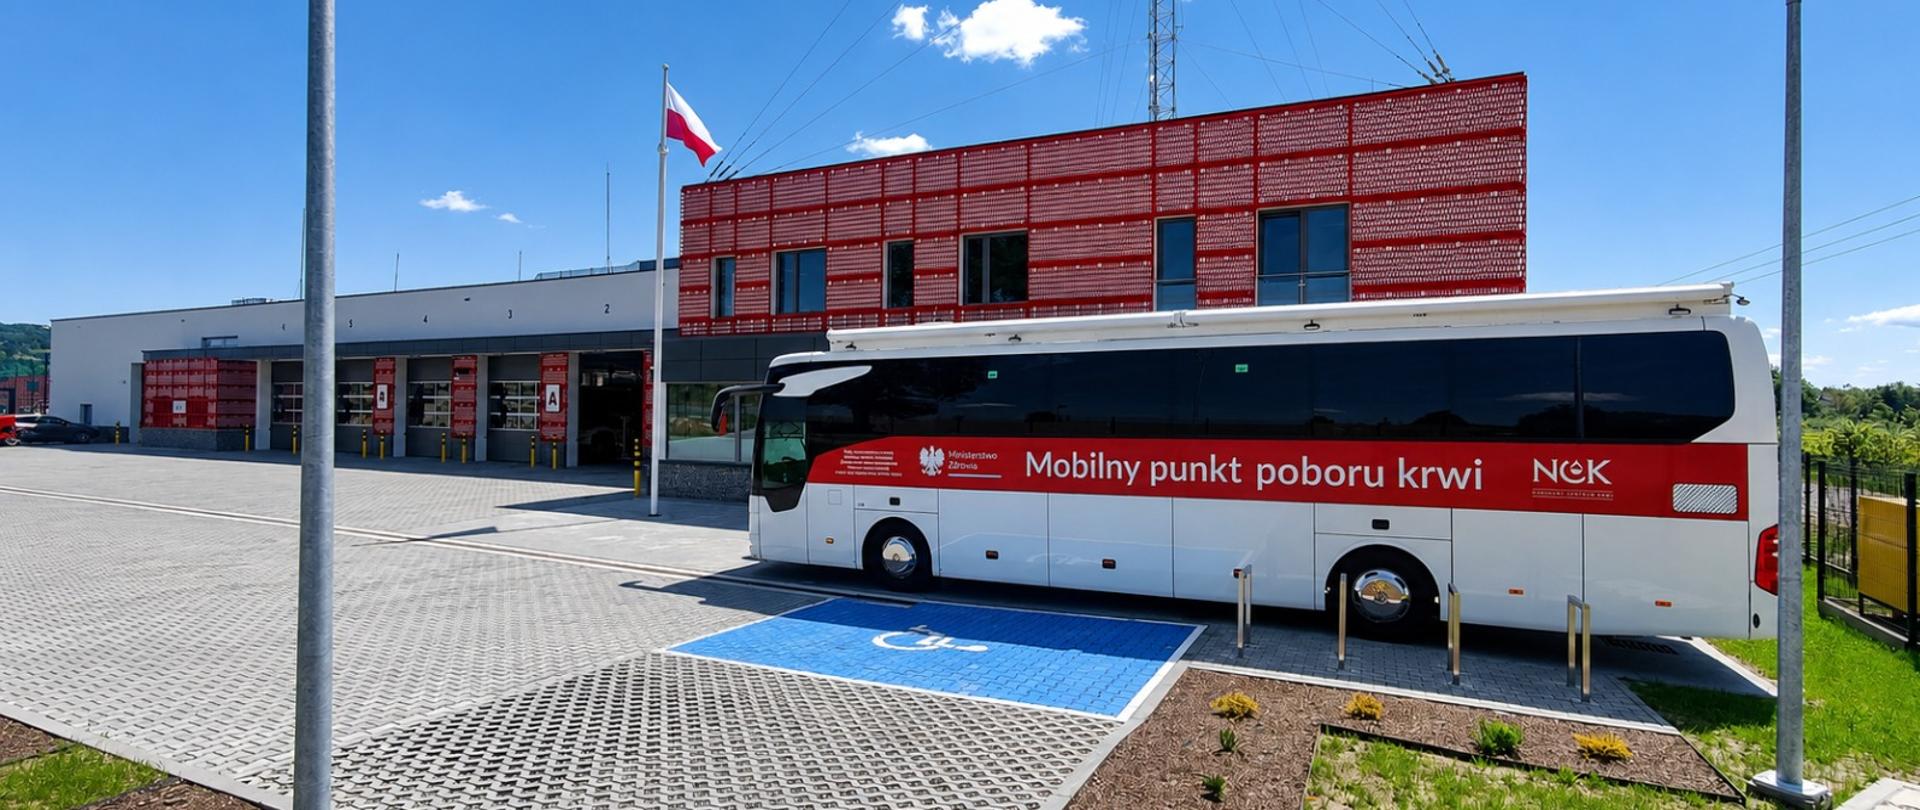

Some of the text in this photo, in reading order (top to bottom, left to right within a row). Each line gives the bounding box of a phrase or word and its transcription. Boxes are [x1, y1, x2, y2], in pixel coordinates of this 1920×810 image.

[508, 309, 513, 319] 3
[604, 303, 610, 314] 2
[548, 391, 557, 406] A
[1026, 451, 1483, 491] Mobilny punkt poboru krwi
